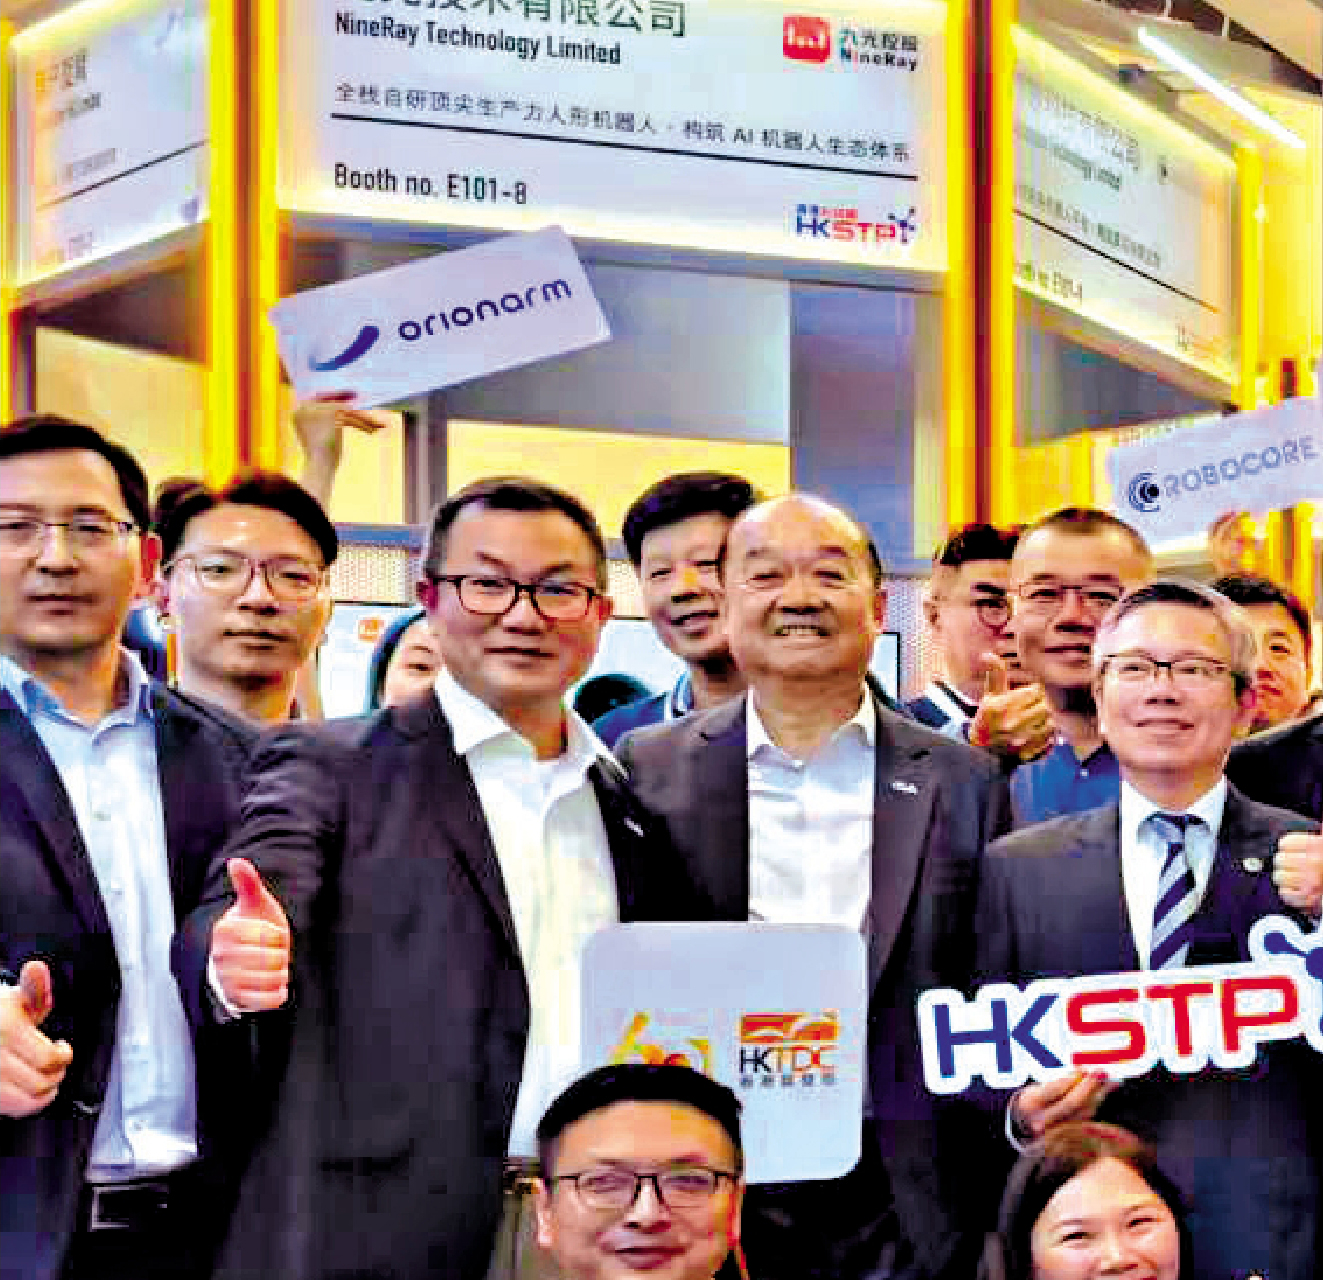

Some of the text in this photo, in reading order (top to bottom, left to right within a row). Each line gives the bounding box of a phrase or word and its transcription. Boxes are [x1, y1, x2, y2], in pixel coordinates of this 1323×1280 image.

[335, 11, 621, 65] NineRay Technology Limited
[335, 162, 396, 193] Booth
[405, 174, 438, 197] no.
[398, 276, 573, 342] orionarm
[1163, 435, 1318, 497] ROBOCORE
[934, 977, 1296, 1077] HKSTP
